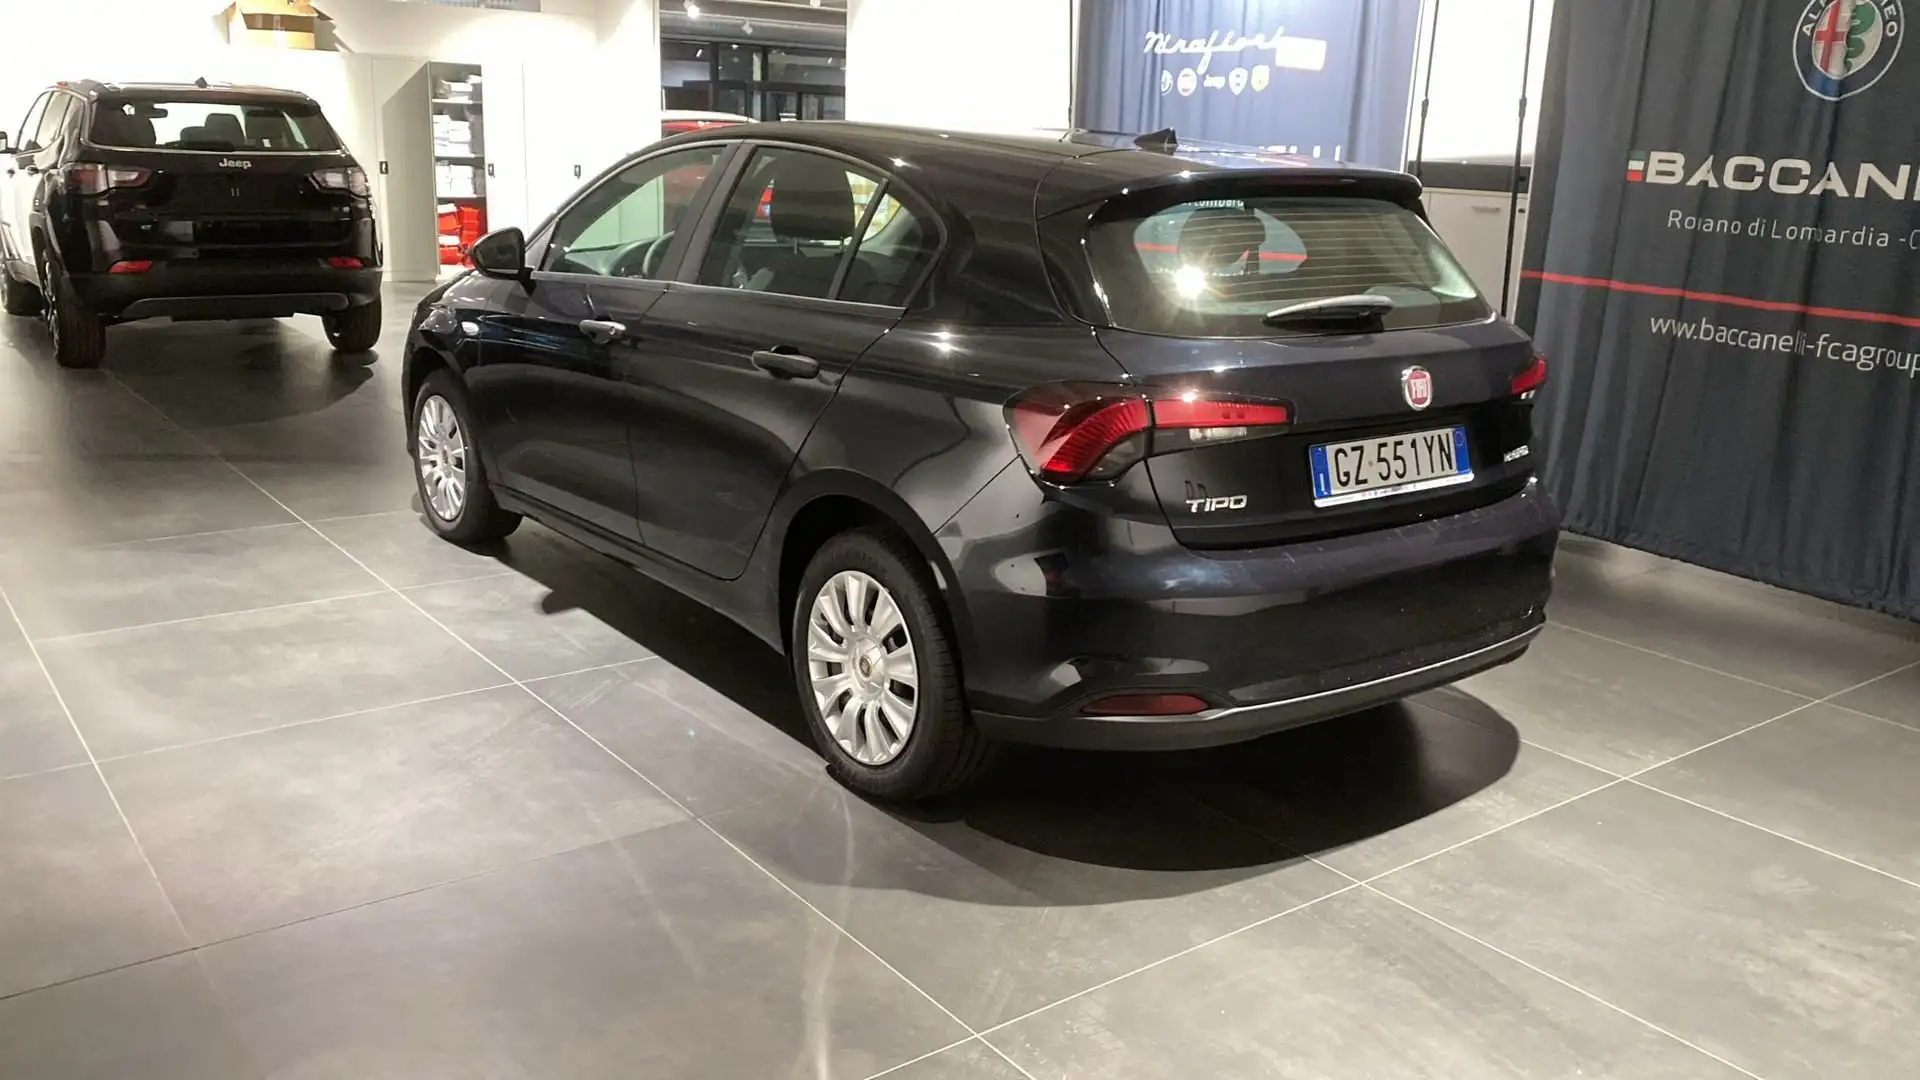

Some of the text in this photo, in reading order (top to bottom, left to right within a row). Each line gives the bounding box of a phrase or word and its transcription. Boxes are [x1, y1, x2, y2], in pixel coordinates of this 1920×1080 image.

[218, 157, 252, 170] Jeep
[1646, 151, 1920, 200] BACCAN
[1667, 208, 1743, 234] Roano
[1748, 217, 1767, 237] di
[1334, 447, 1368, 487] GZ
[1376, 432, 1454, 481] 551YN
[1186, 495, 1248, 512] TIPO
